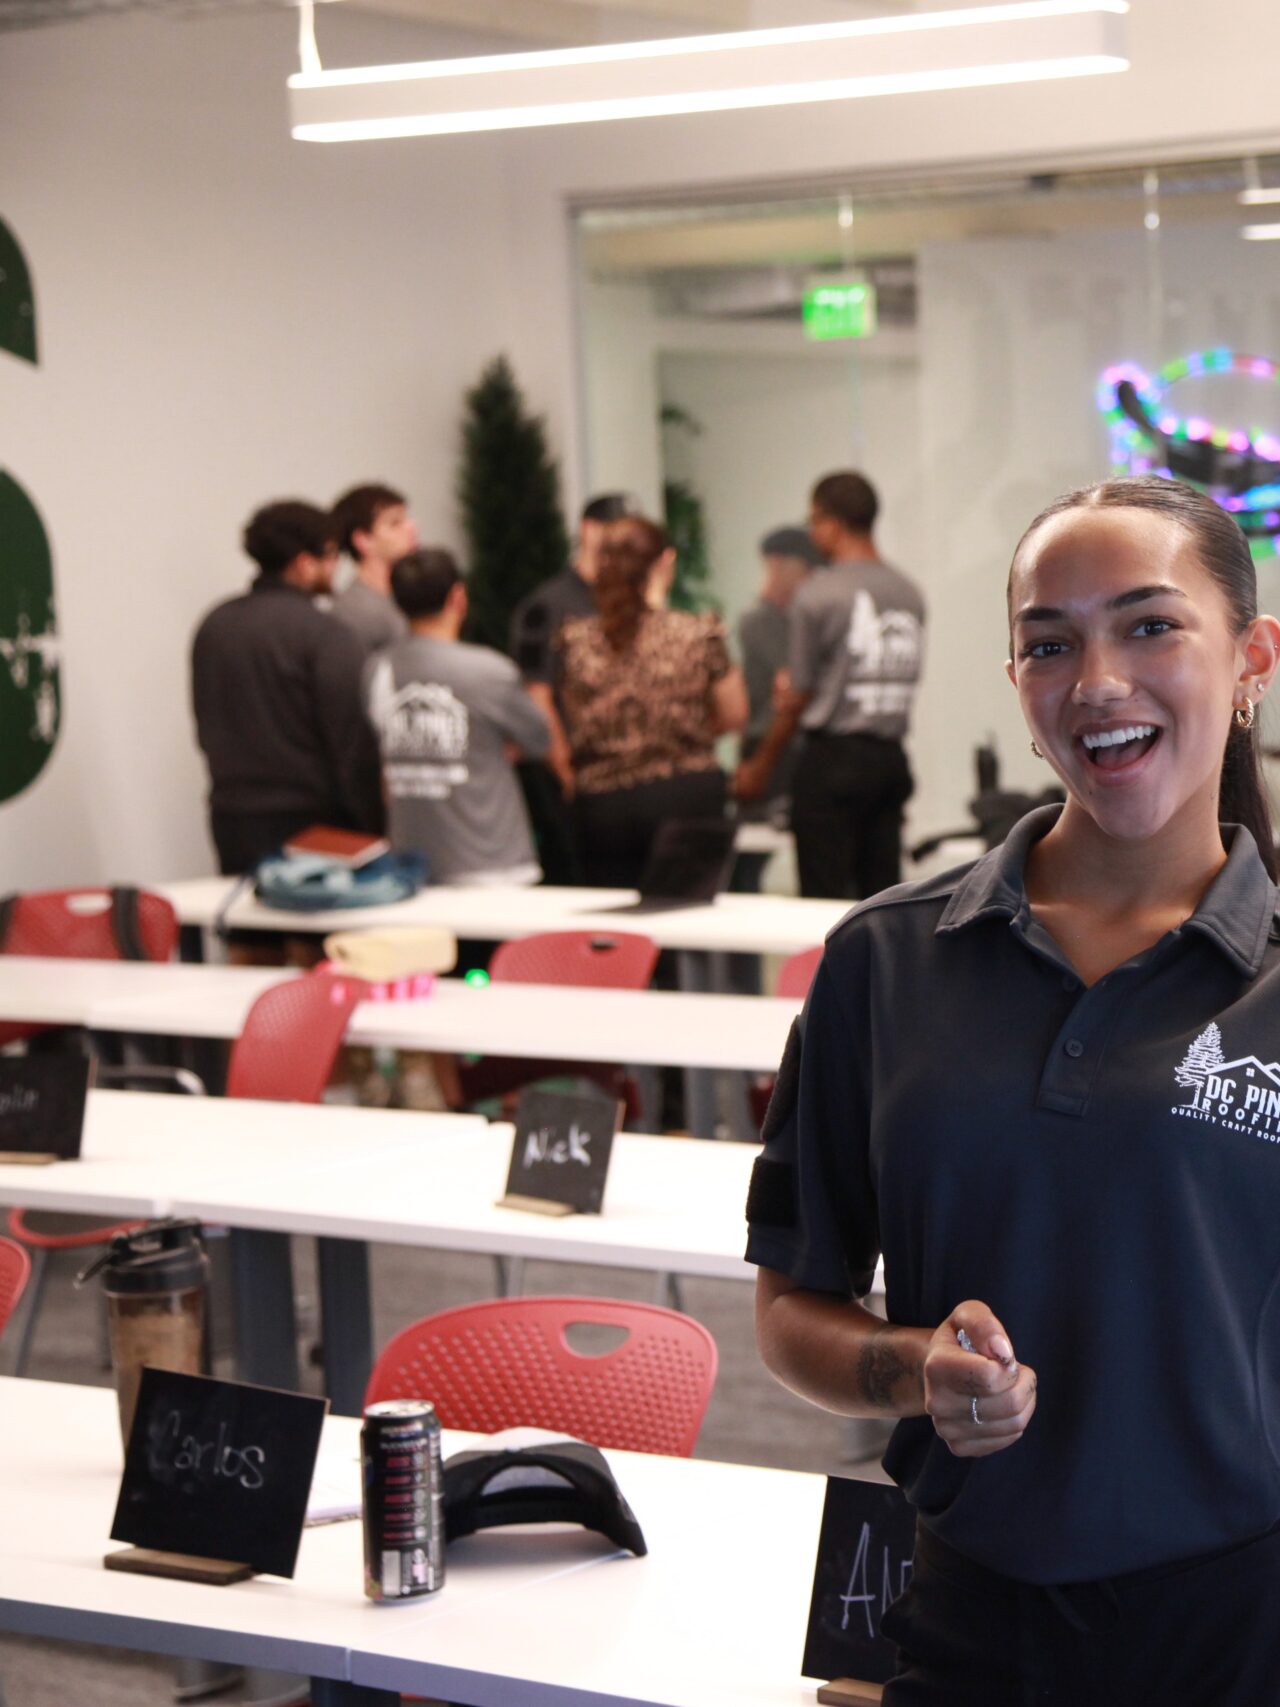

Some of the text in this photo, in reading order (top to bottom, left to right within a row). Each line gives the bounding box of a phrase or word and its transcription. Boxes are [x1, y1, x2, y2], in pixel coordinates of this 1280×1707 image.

[1205, 1075, 1236, 1104] DC
[1171, 1106, 1217, 1124] QUALITY
[1221, 1119, 1253, 1135] CRAFT
[523, 1123, 592, 1169] Nick
[148, 1409, 265, 1489] Carlos
